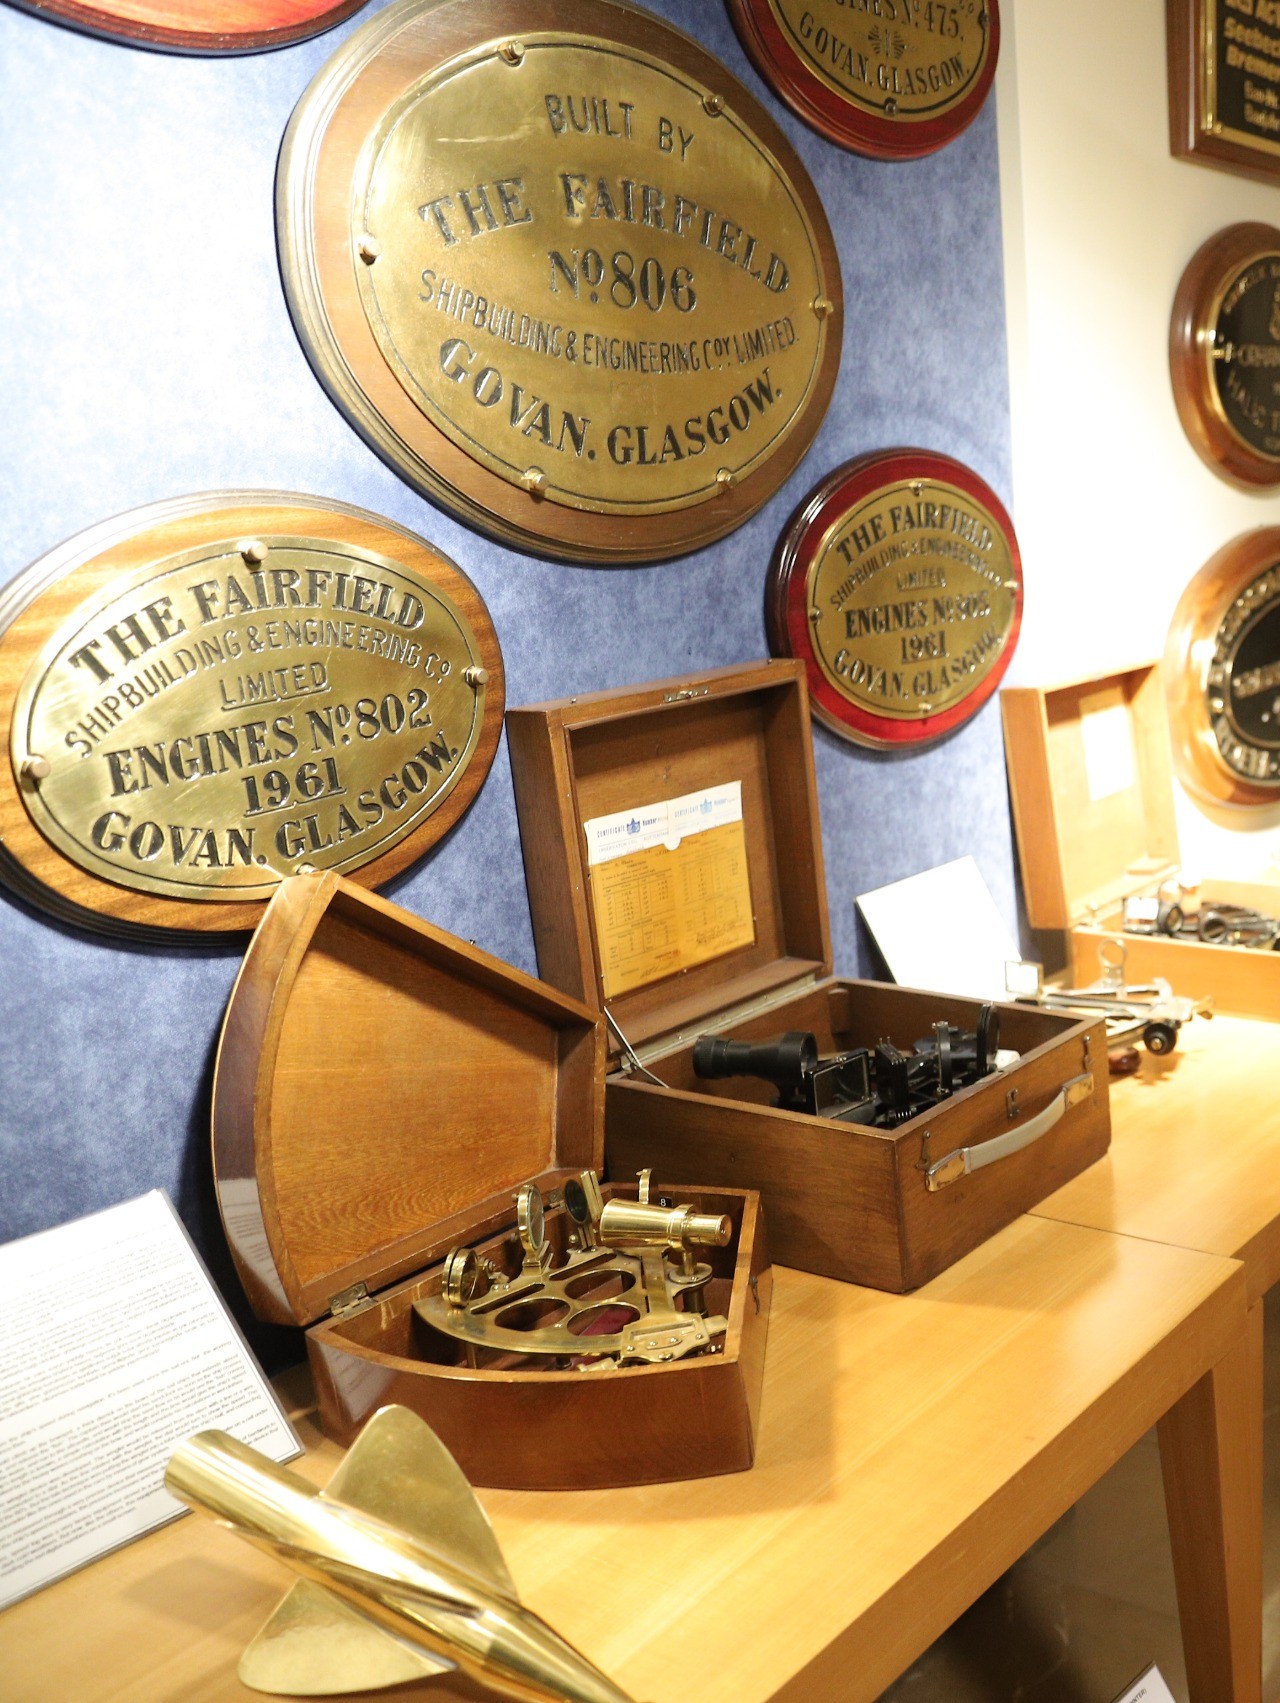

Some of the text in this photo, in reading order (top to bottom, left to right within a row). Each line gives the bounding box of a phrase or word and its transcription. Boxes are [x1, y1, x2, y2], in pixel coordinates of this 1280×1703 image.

[800, 11, 970, 96] GOVAN. GLASGOW.
[544, 94, 695, 164] BUILT BY
[417, 172, 791, 295] THE FAIRFIELD
[418, 269, 563, 358] SHIPBUILDING
[581, 333, 701, 376] ENGINEERING
[438, 336, 784, 467] GOVAN. GLASGOW.
[836, 500, 994, 568] THE FAIRFIELD
[829, 540, 909, 612] SHIPBUILDING
[68, 567, 425, 687] THE FAIRFIELD
[844, 596, 930, 640] ENGINES
[900, 630, 950, 664] 1961
[65, 630, 243, 760] SHIPBUILDING
[246, 625, 267, 654] &
[267, 618, 420, 668] ENGINEERING
[219, 661, 329, 708] LIMITED
[833, 648, 910, 699] GOVAN.
[103, 715, 299, 800] ENGINES
[241, 757, 347, 816] 1961
[91, 730, 460, 870] GOVAN. GLASGOW.
